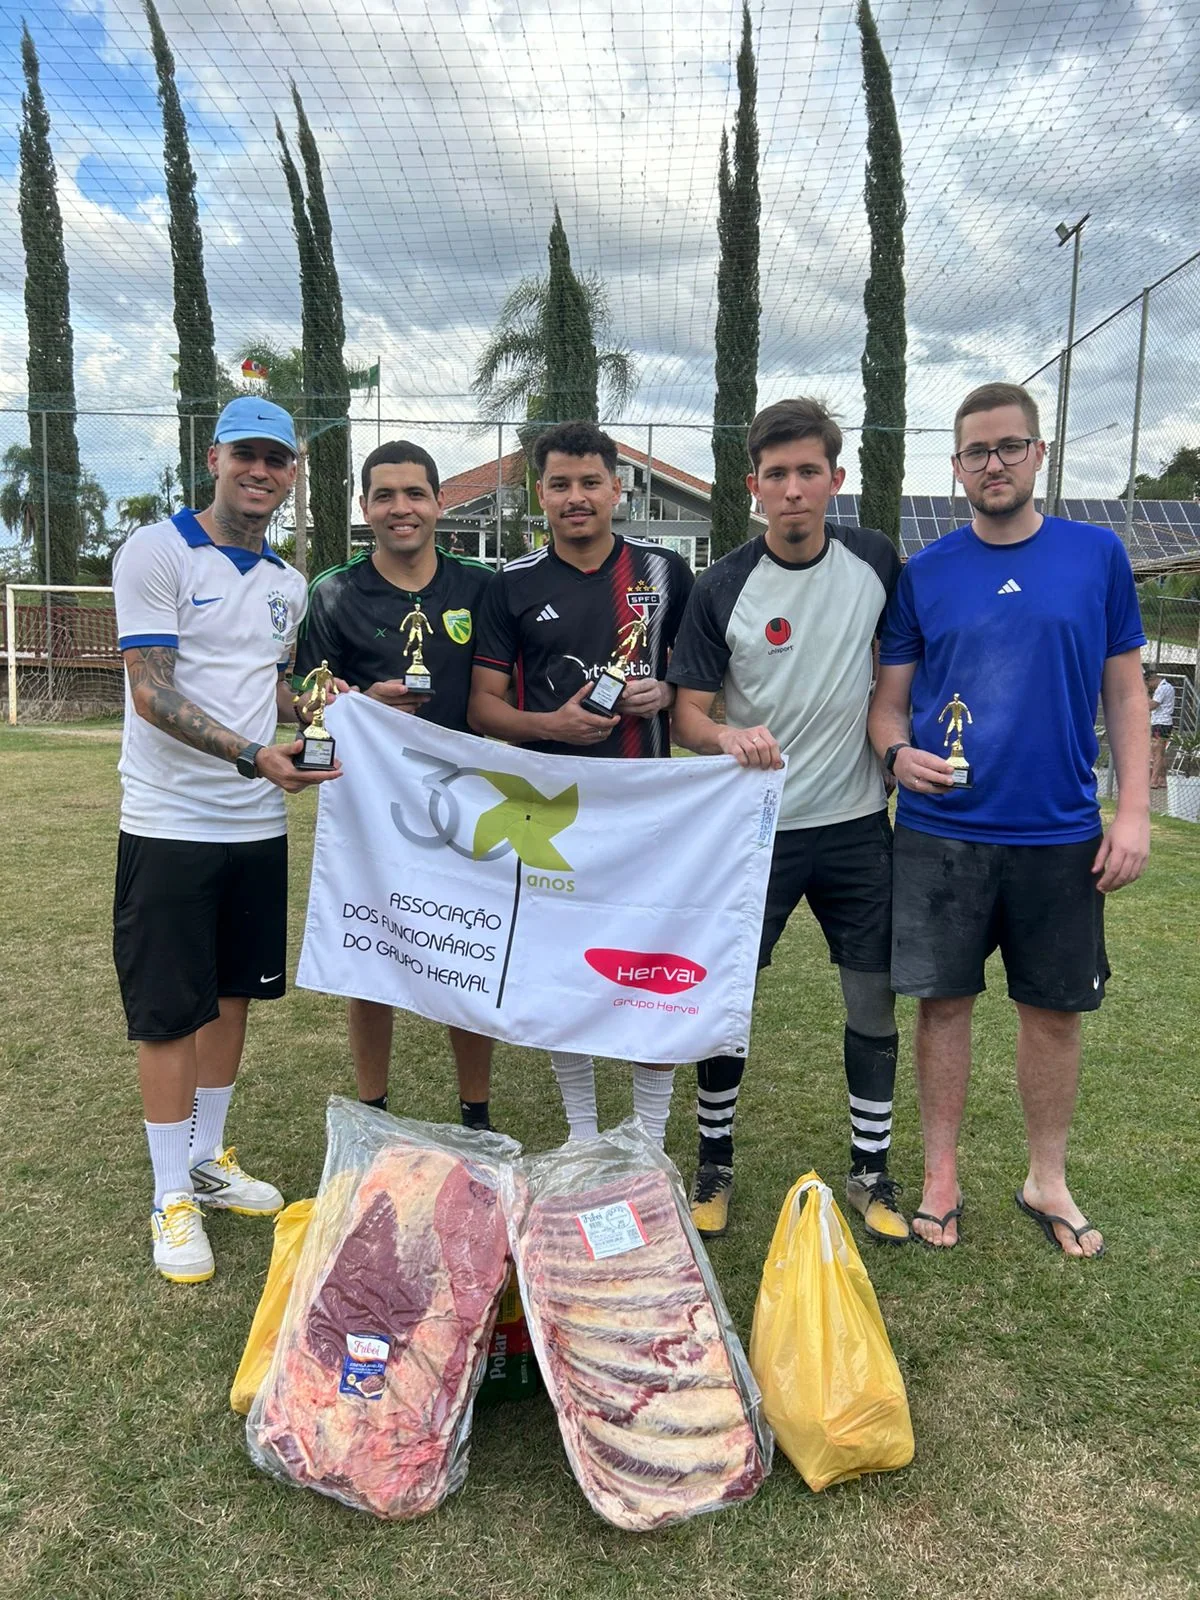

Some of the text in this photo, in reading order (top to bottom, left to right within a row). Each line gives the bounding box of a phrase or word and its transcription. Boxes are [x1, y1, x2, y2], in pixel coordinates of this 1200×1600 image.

[631, 595, 657, 603] SPFC
[526, 874, 576, 893] anos
[390, 892, 502, 931] ASSOCIAÇÃO
[342, 903, 497, 962] DOS FUNCIONÁRIOS
[343, 932, 490, 994] DO GRUPO HERVAL
[613, 998, 700, 1015] Grupo Herval
[489, 1332, 508, 1380] Polar
